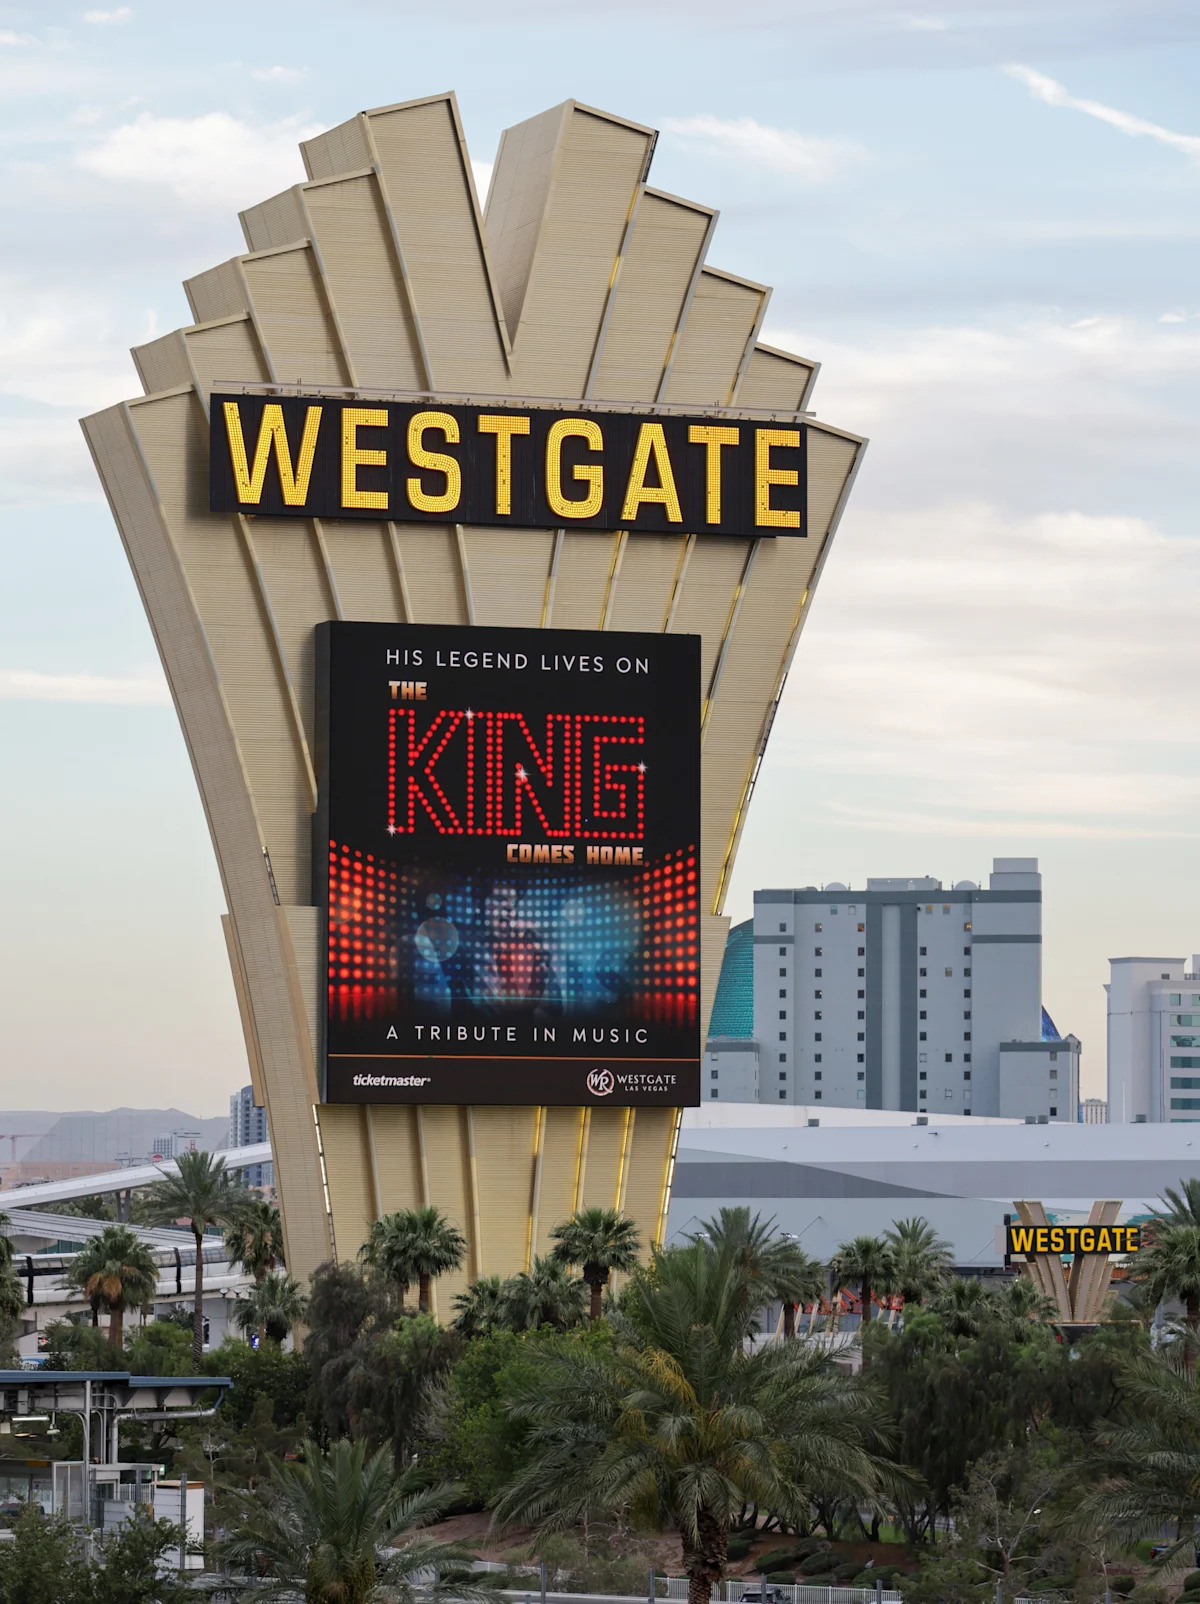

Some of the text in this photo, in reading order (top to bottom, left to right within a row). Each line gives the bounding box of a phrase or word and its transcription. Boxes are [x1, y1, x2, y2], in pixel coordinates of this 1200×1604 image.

[222, 402, 801, 528] WESTGATE
[386, 648, 649, 674] HIS LEGEND LIVES ON
[388, 680, 428, 700] THE
[387, 708, 647, 840] KING
[506, 843, 644, 865] COMES HOME
[386, 1025, 649, 1044] A TRIBUTE IN MUSIC
[616, 1074, 677, 1085] WESTGATE
[1011, 1228, 1139, 1252] WESTGATE
